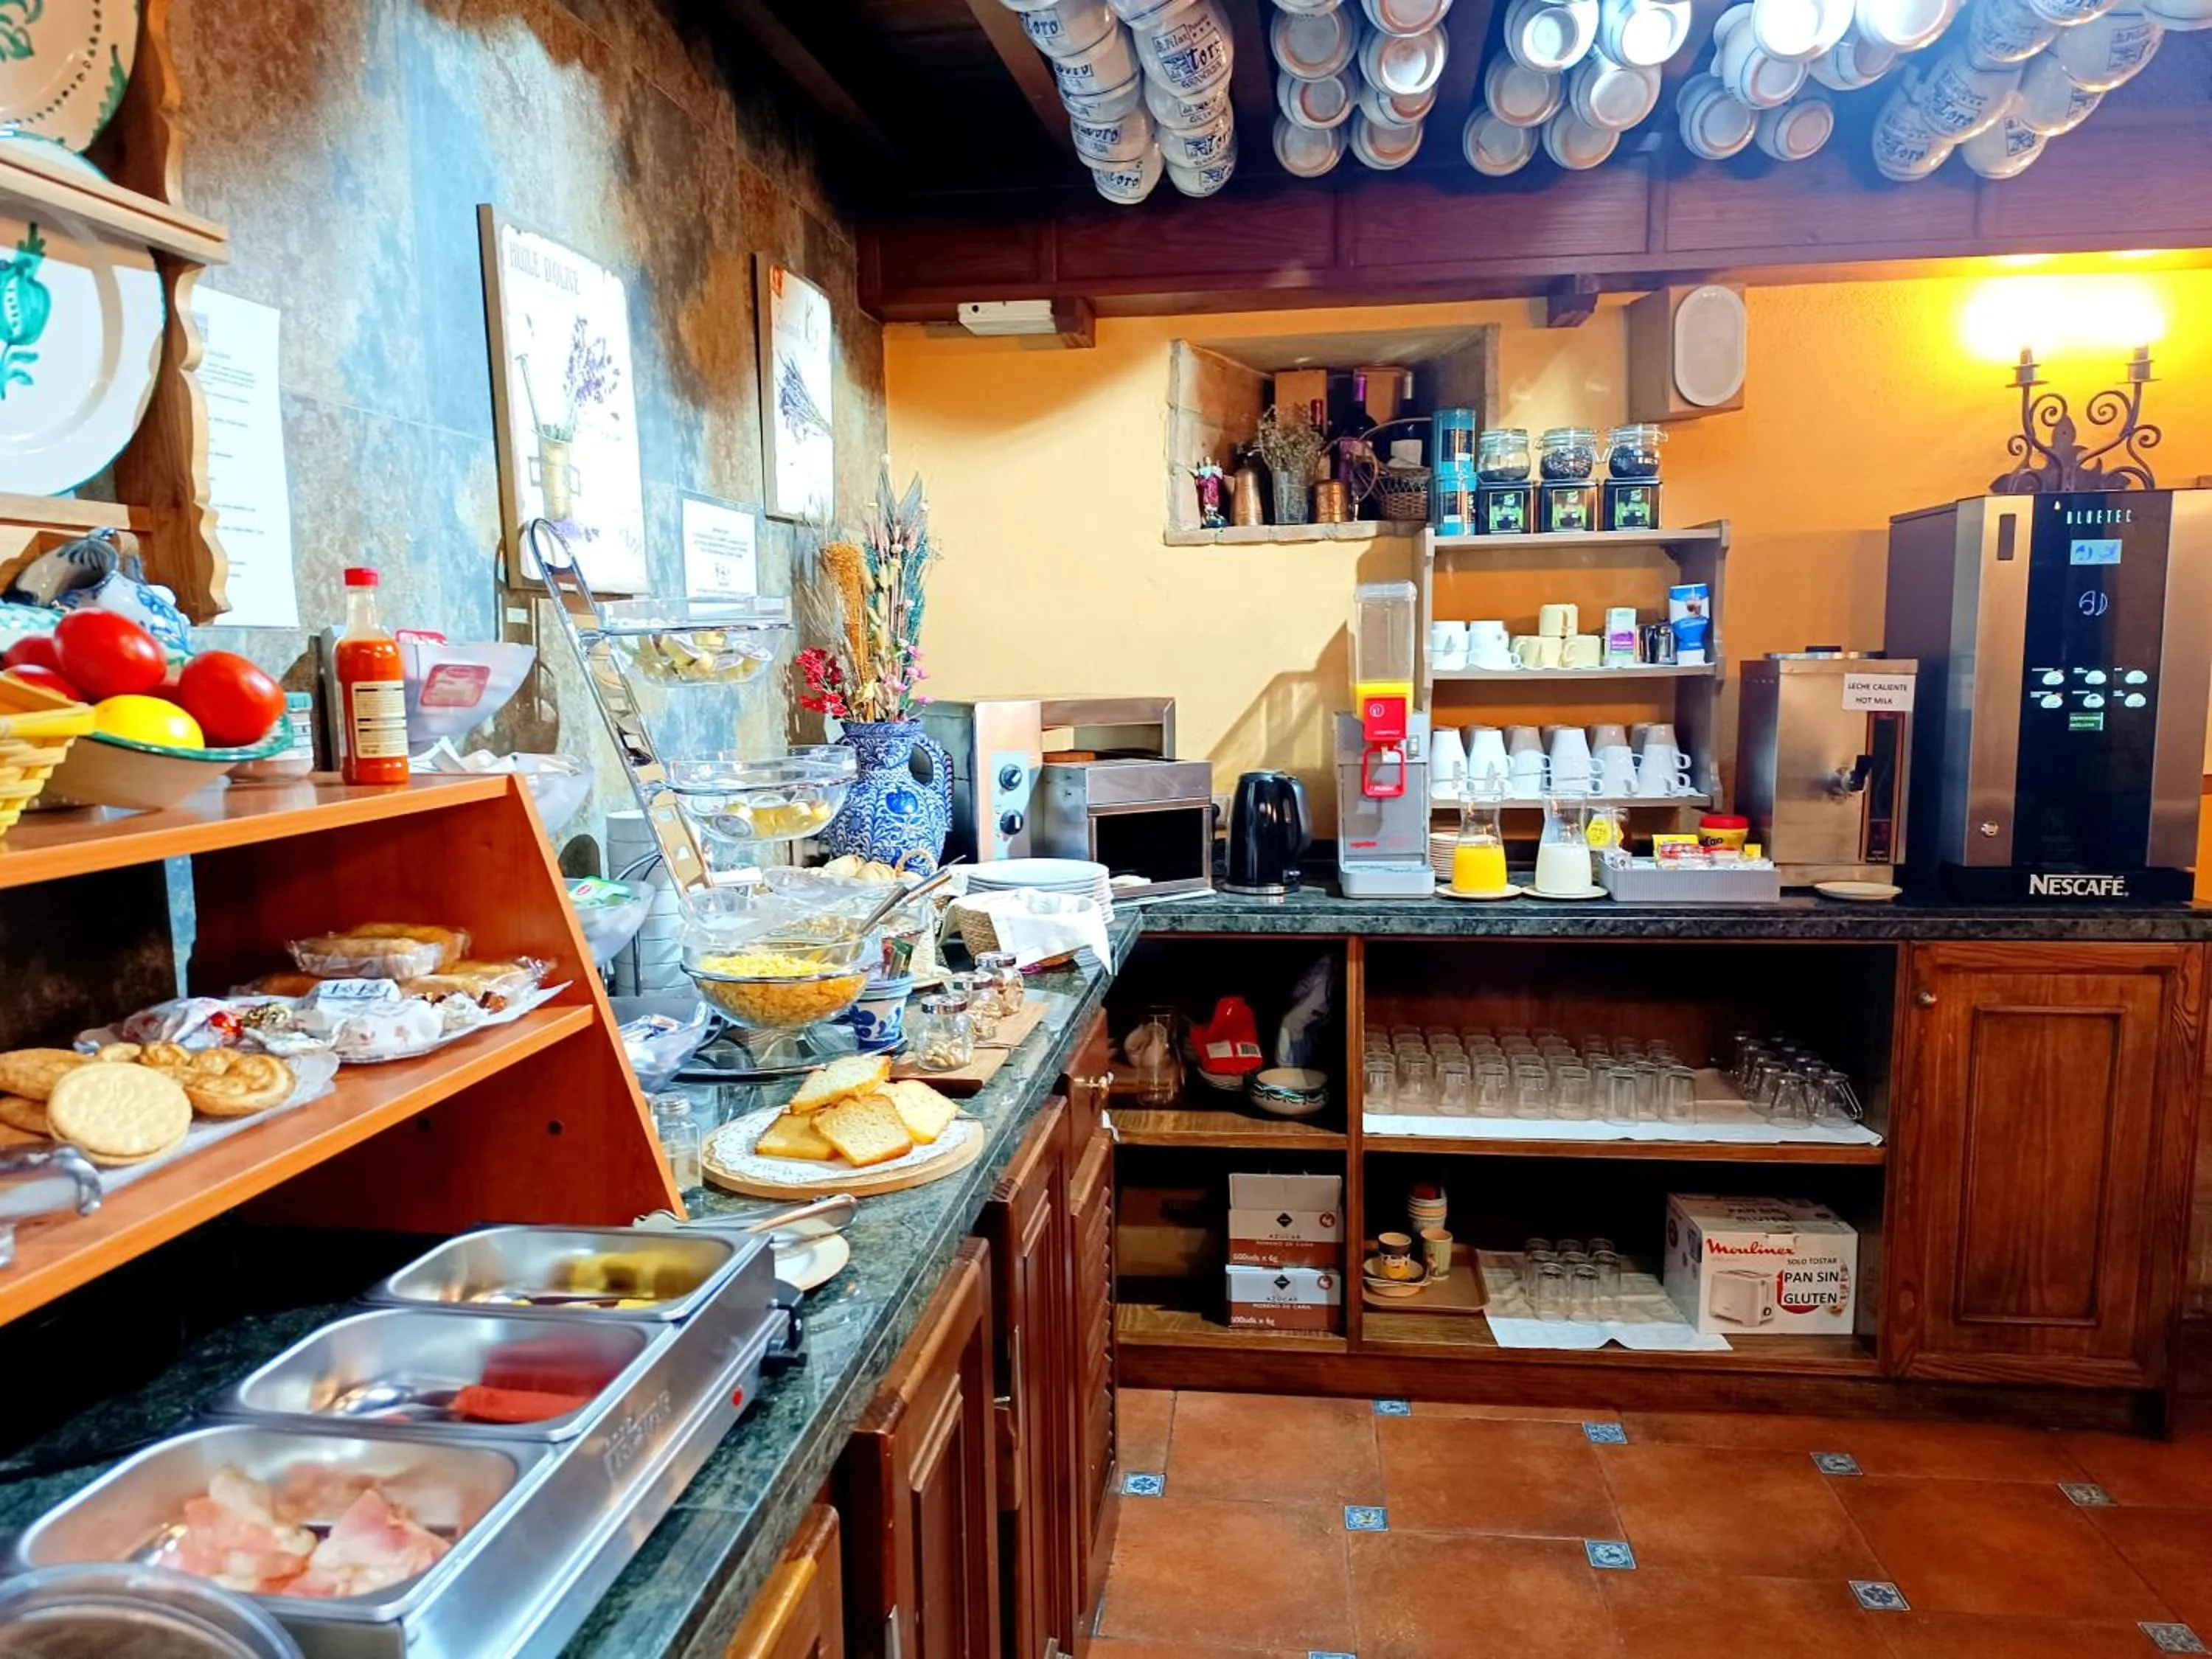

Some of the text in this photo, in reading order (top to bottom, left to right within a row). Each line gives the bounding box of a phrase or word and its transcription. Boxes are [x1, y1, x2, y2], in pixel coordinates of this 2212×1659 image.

[509, 240, 540, 279] HUILE
[2067, 509, 2132, 524] BLUETEC
[1847, 682, 1908, 692] LECHE CALIENTE
[1874, 697, 1893, 705] MILK
[2028, 874, 2125, 896] NESCAFÉ
[1706, 1238, 1795, 1255] Moulinex
[1784, 1272, 1839, 1282] PAN SIN
[1784, 1293, 1837, 1304] GLUTEN
